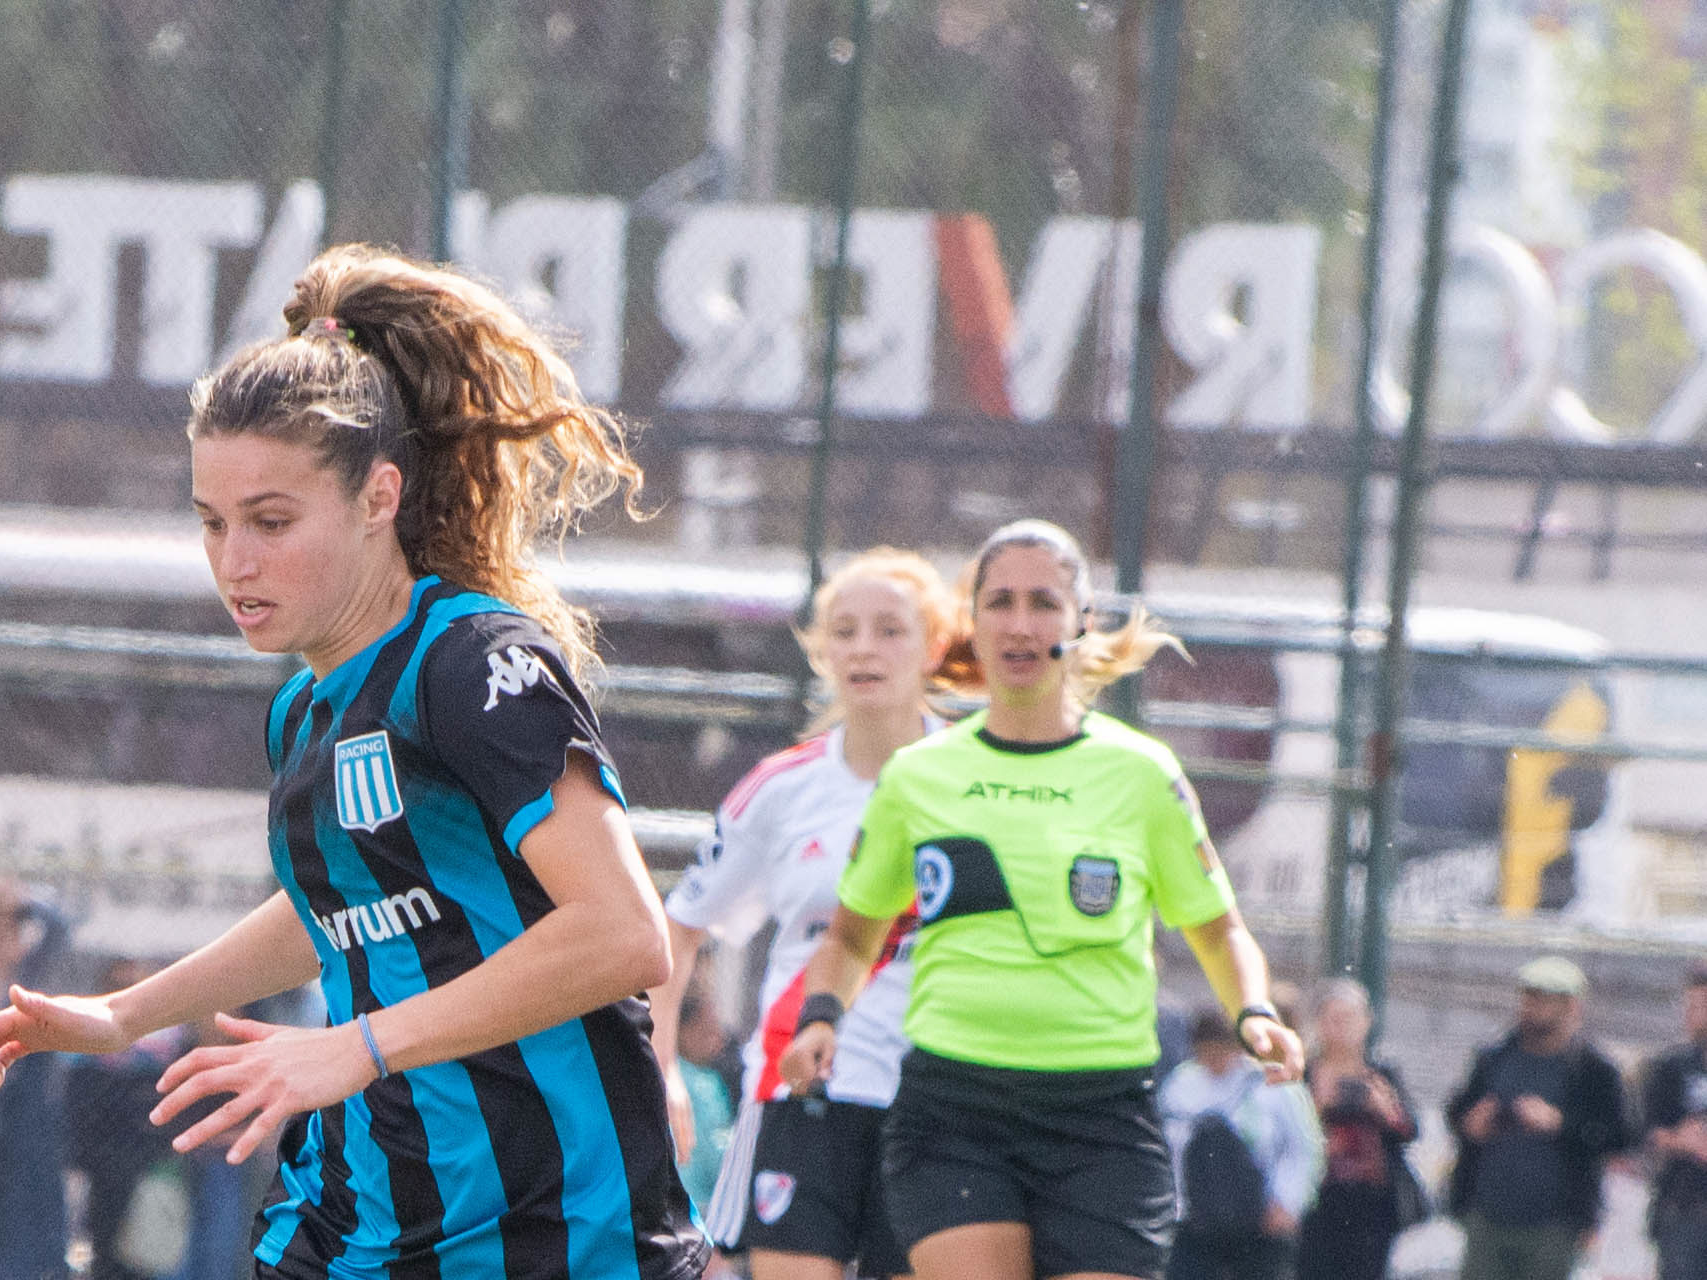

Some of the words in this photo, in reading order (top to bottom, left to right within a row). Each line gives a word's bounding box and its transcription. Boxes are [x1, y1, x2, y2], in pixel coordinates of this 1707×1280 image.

[338, 739, 384, 760] RACING
[963, 780, 1074, 805] ATHIX
[310, 887, 441, 952] rrum
